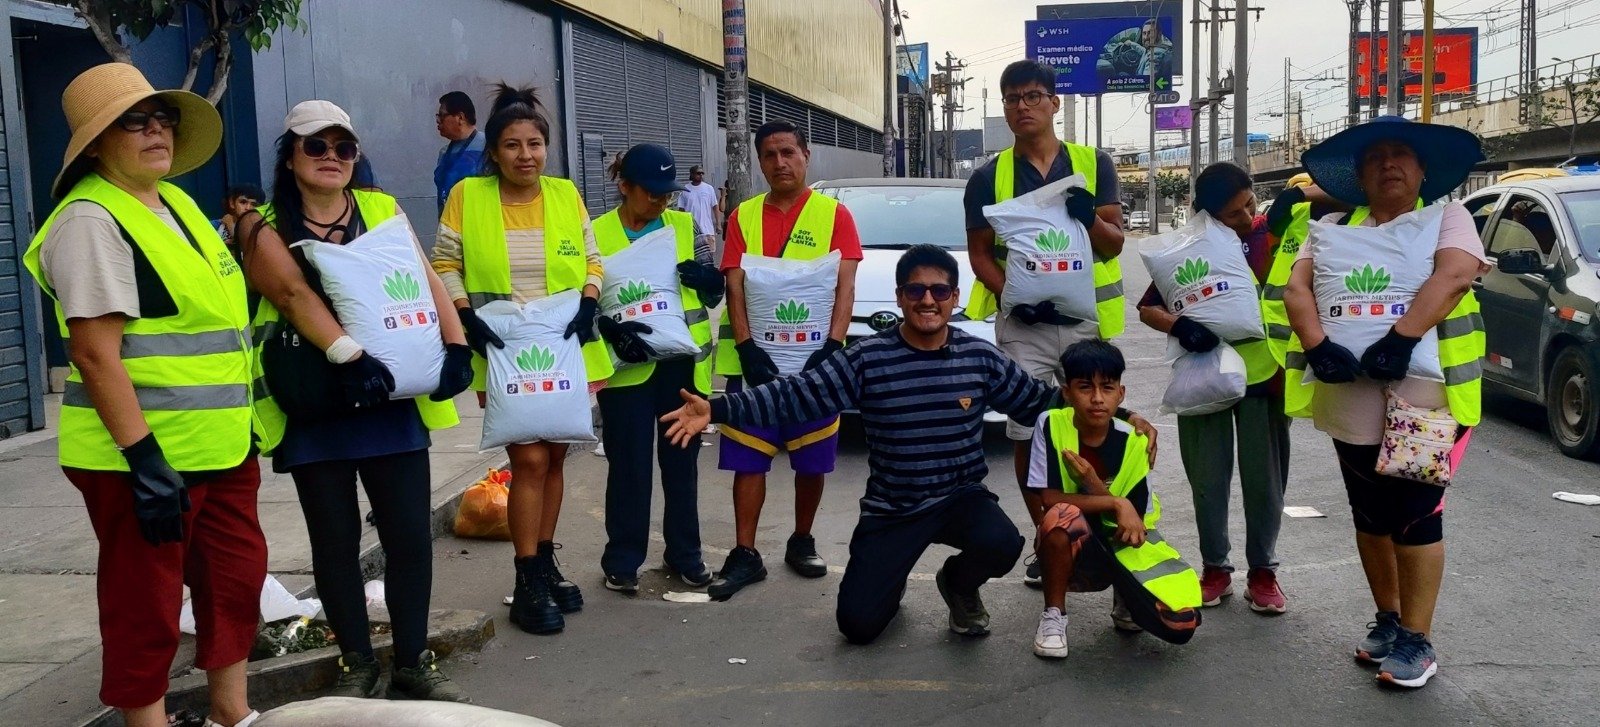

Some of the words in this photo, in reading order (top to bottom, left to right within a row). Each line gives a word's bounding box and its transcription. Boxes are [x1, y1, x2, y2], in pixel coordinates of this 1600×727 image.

[1067, 44, 1093, 52] médico
[1037, 55, 1080, 65] Brevete
[793, 233, 814, 241] SALVA
